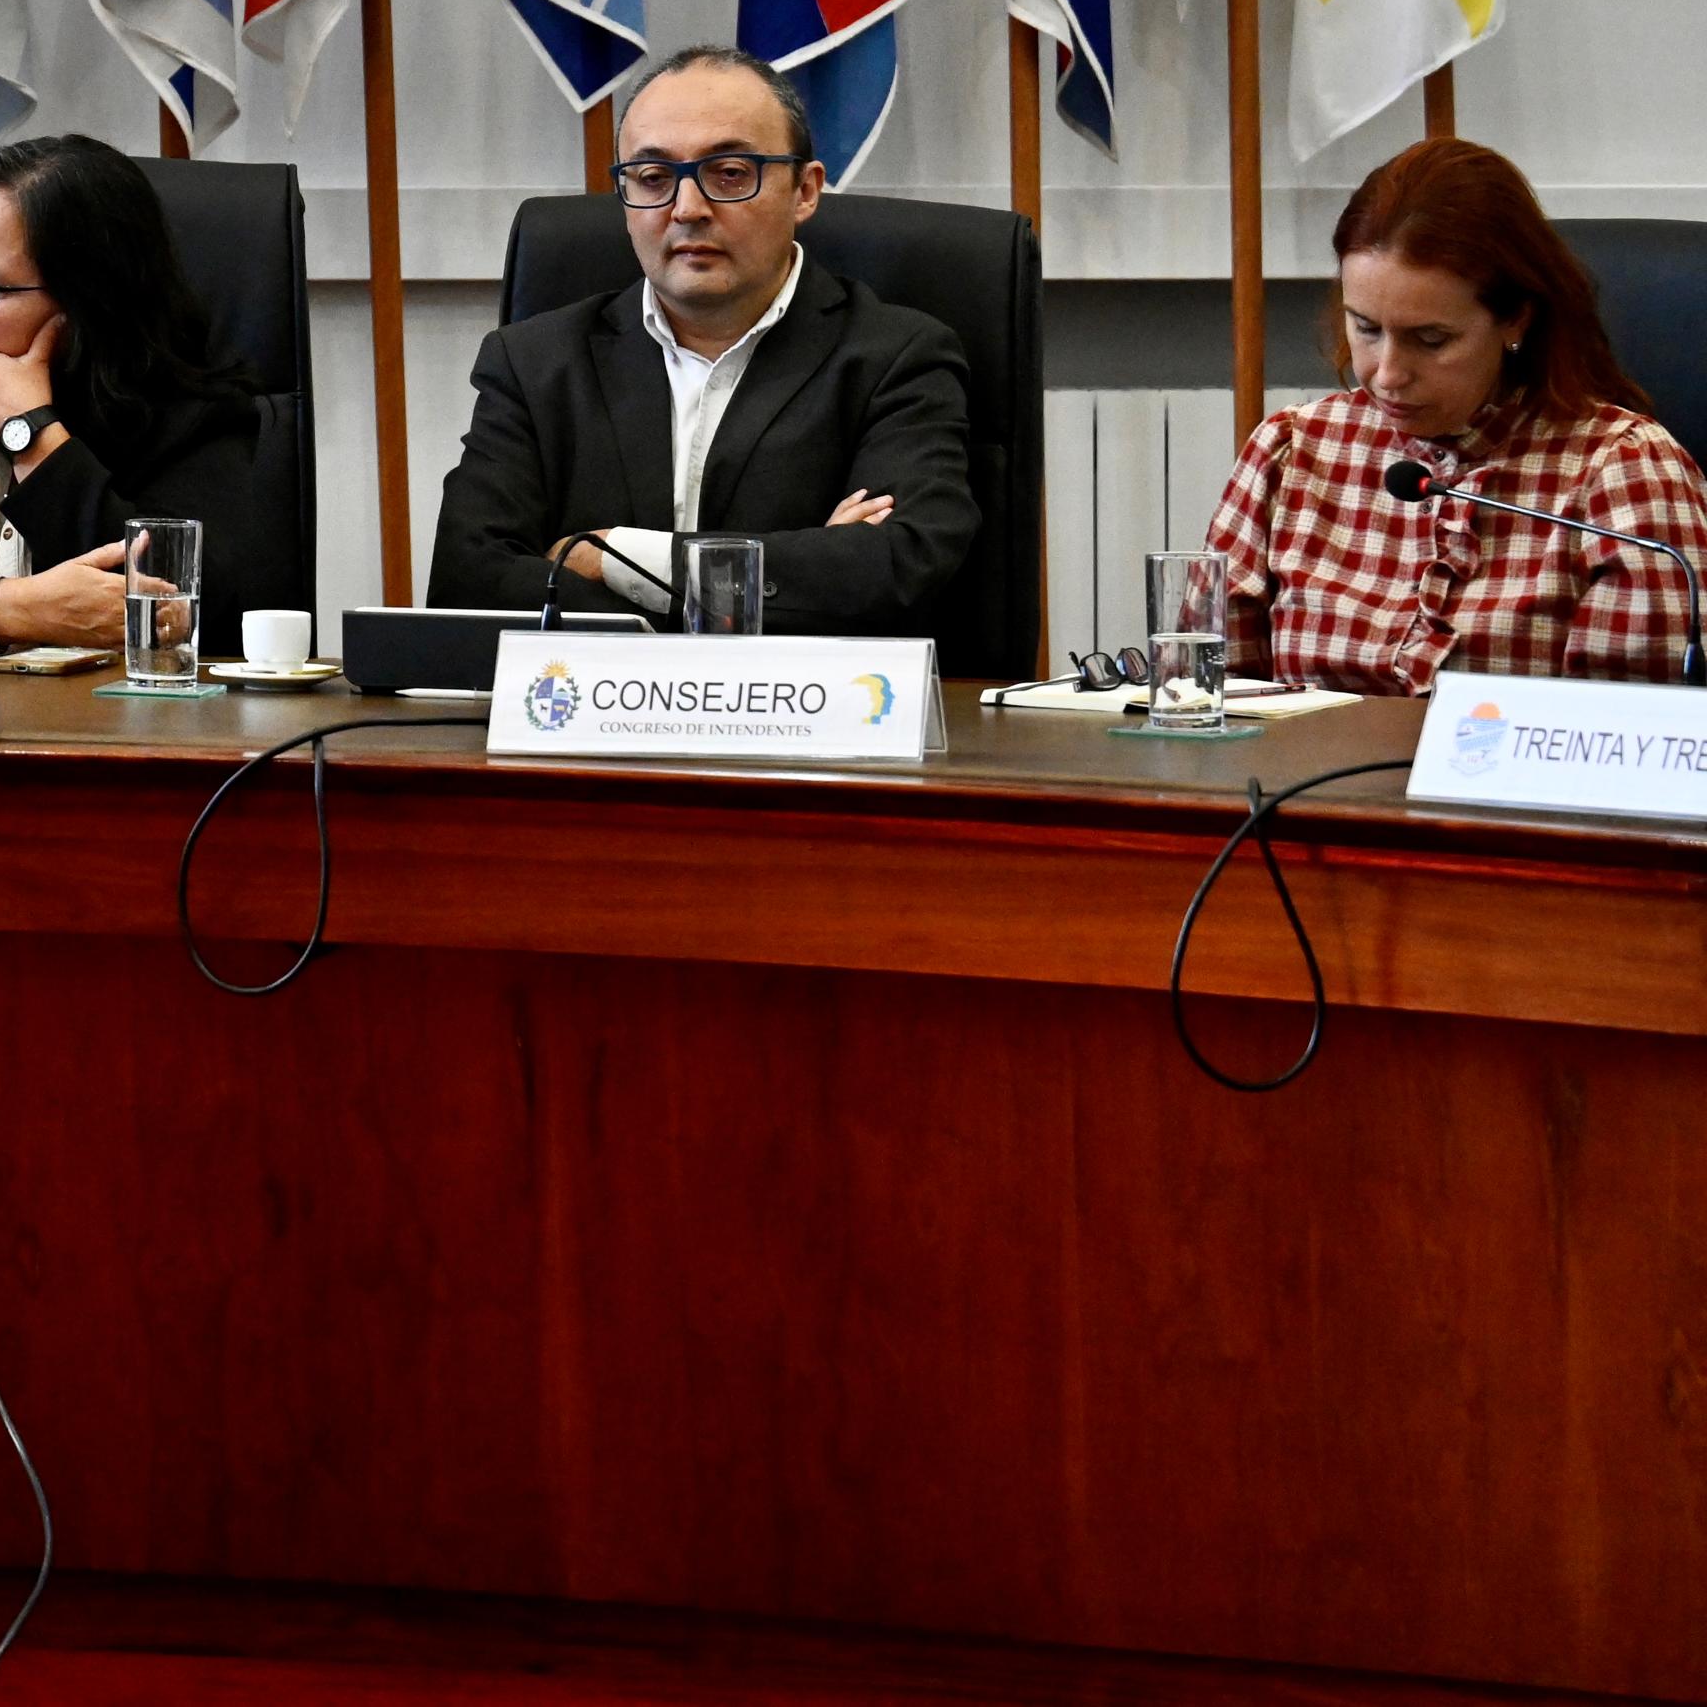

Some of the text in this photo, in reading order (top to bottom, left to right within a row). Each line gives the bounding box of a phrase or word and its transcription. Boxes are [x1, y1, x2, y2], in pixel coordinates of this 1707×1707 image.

[592, 679, 827, 715] CONSEJERO
[599, 721, 812, 737] CONGRESO DE INTENDENTES
[1513, 726, 1707, 772] TREINTA Y TRE
